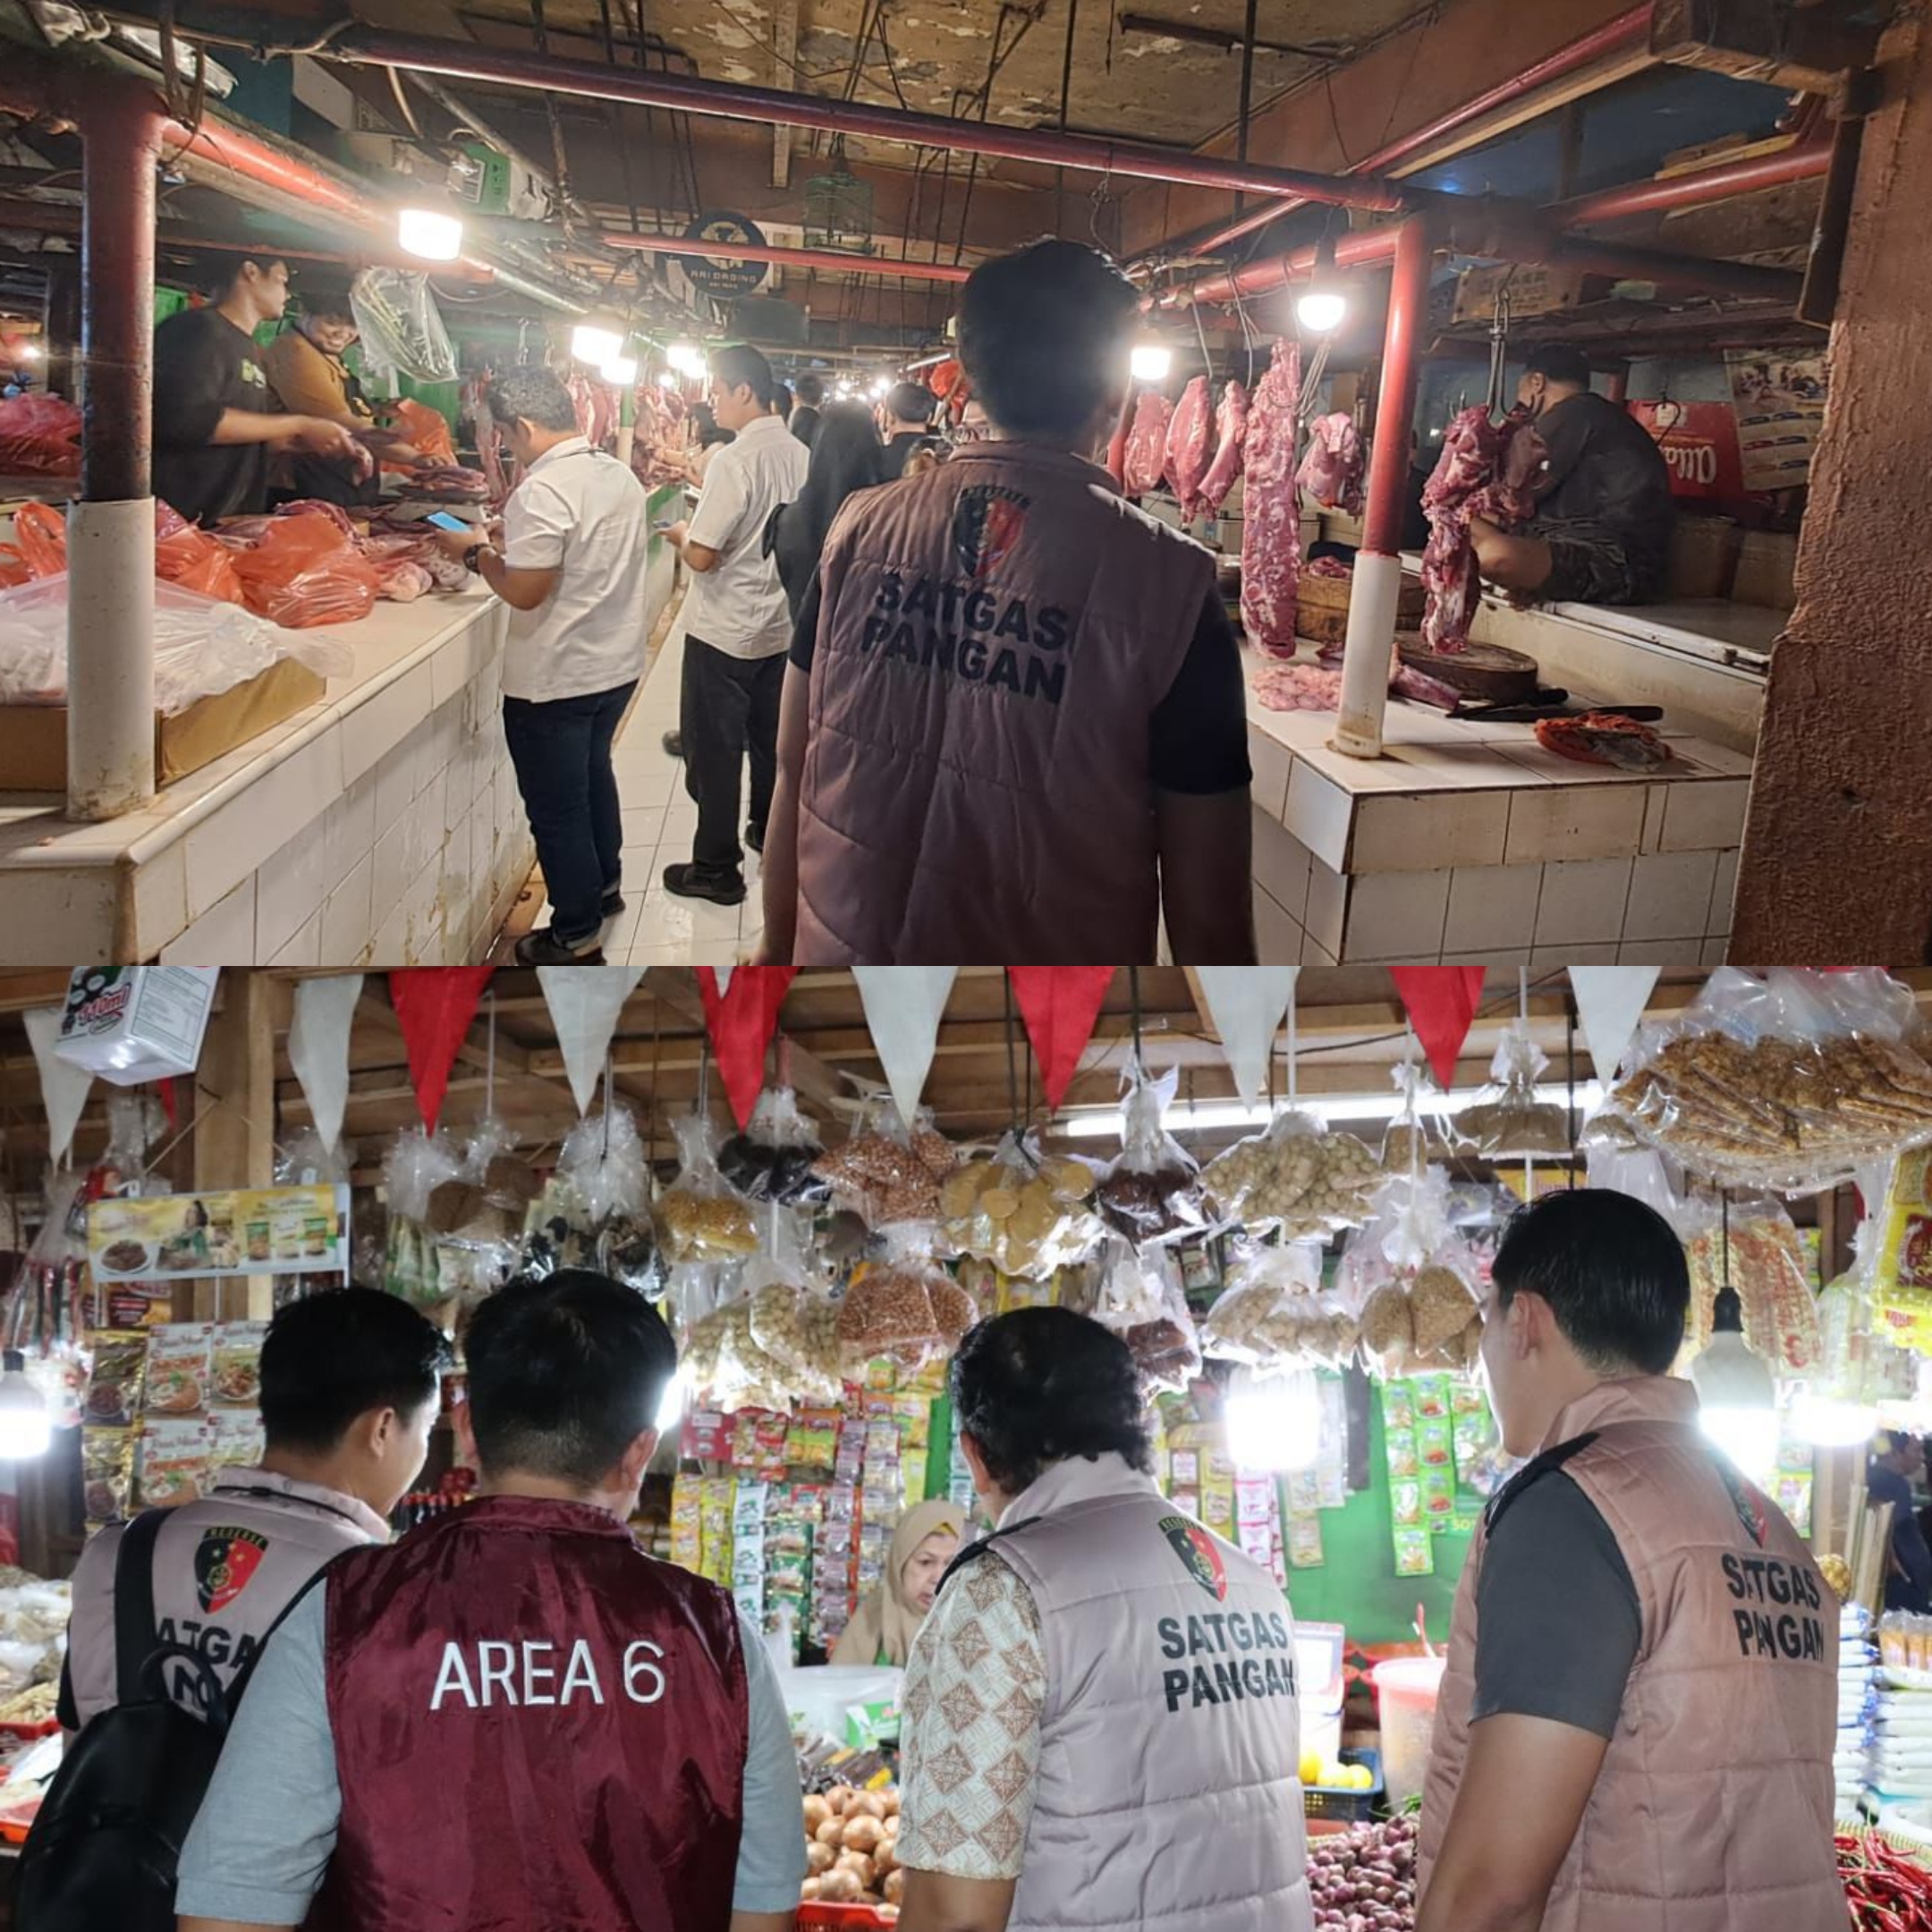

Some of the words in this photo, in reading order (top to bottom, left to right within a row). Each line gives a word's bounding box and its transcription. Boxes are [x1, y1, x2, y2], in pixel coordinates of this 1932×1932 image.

[876, 570, 1068, 651] SATGAS
[860, 616, 1066, 704] PANGAN
[1158, 1613, 1288, 1659] SATGAS
[429, 1639, 605, 1710] AREA
[623, 1640, 665, 1703] 6
[1164, 1658, 1295, 1712] PANGAN
